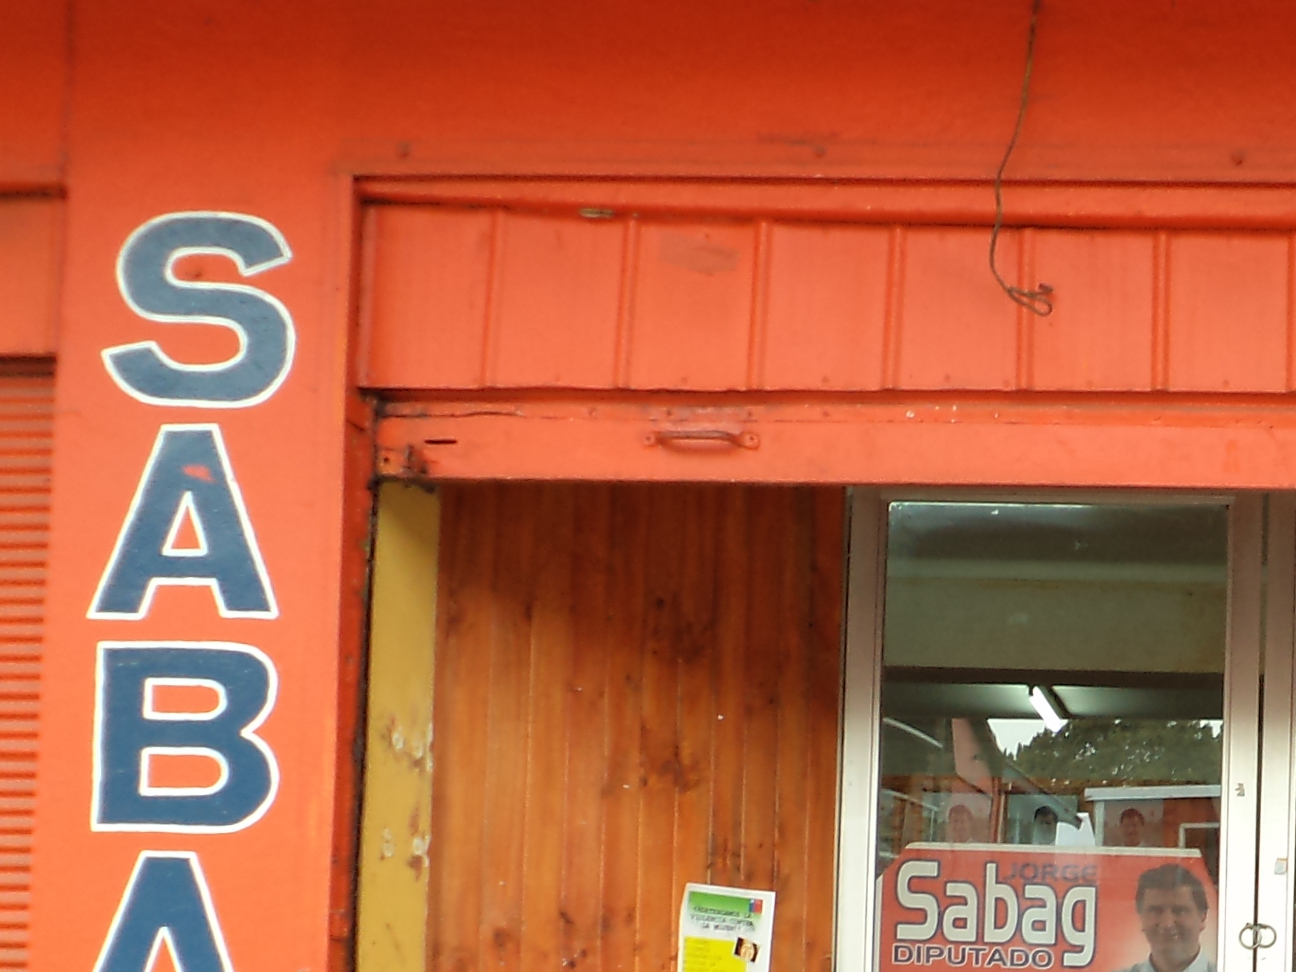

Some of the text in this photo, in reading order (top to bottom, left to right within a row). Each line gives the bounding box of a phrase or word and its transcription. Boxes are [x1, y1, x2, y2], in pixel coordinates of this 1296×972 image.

[1005, 861, 1098, 885] JORGE
[895, 858, 1098, 968] Sabag
[892, 944, 1055, 969] DIPUTADO
